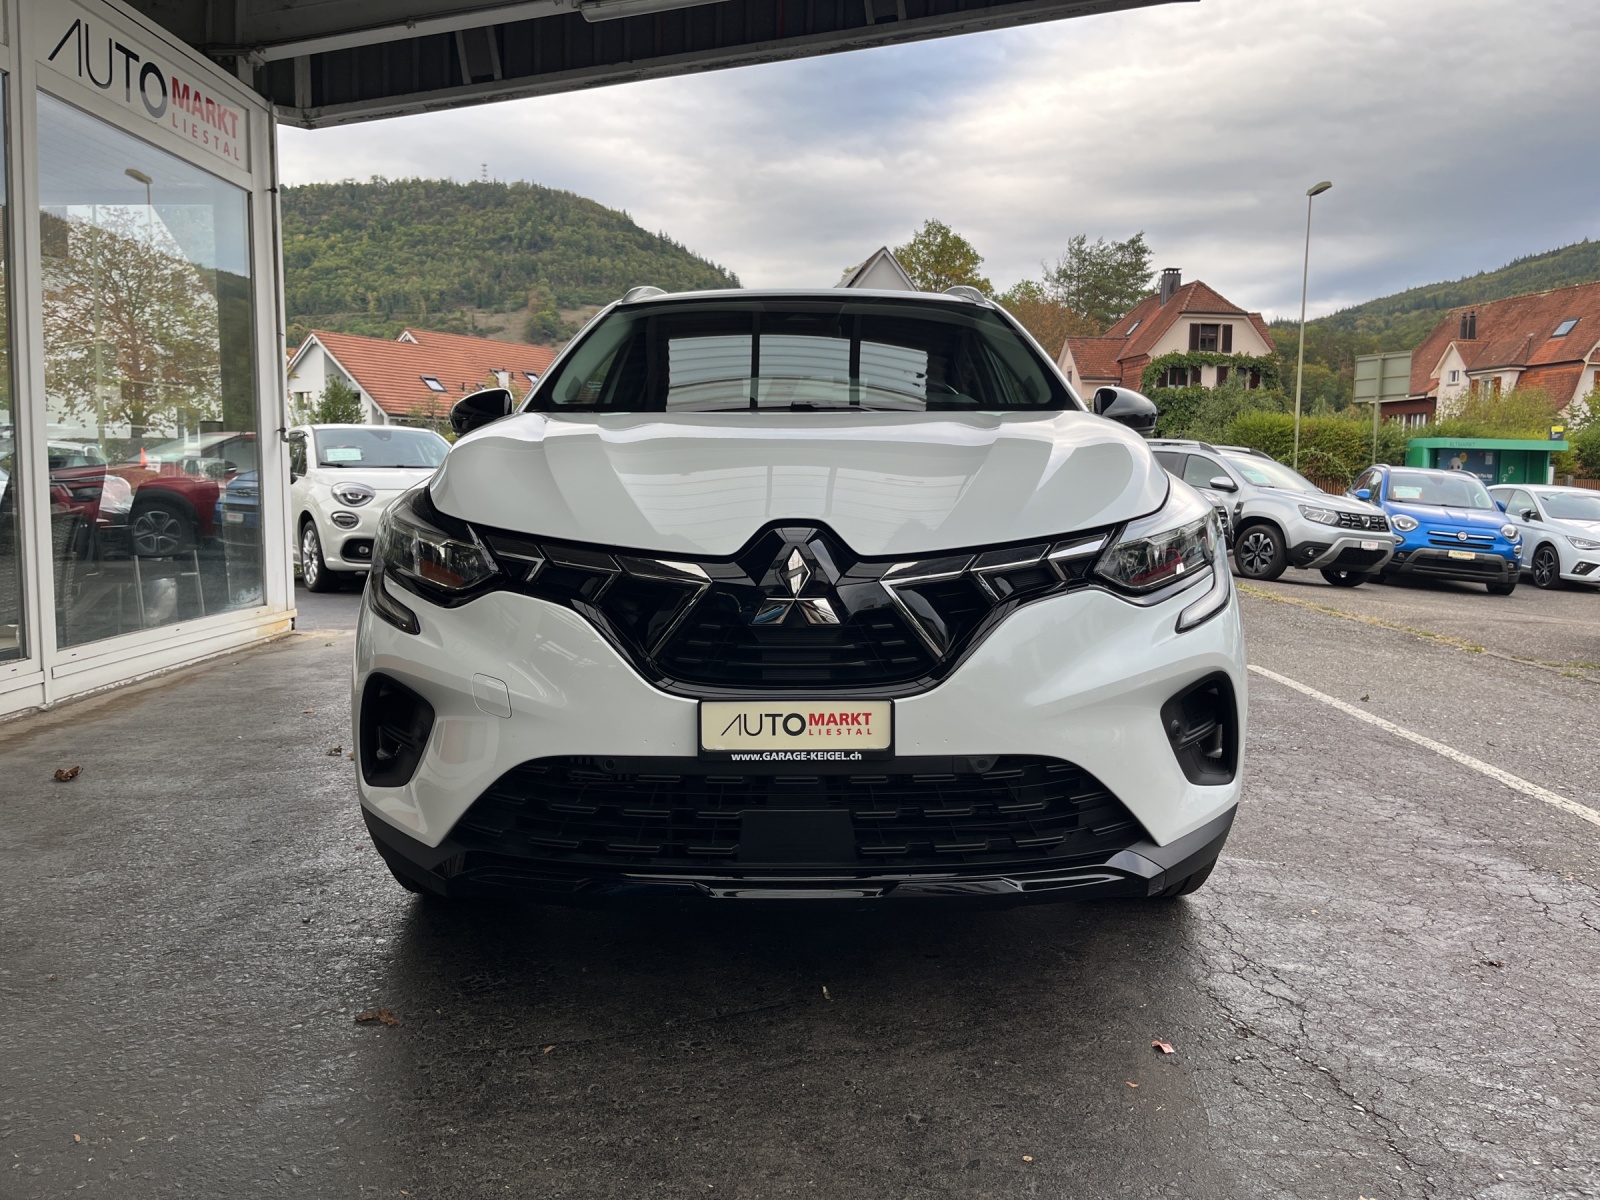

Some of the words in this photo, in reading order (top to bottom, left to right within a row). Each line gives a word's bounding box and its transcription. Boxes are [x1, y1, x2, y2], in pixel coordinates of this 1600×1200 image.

[171, 75, 239, 139] MARKT
[171, 111, 240, 161] LIESTAL
[808, 712, 873, 726] MARKT
[808, 728, 873, 736] LIESTAL
[731, 751, 863, 761] www.GARAGE-KEIGEL.ch
